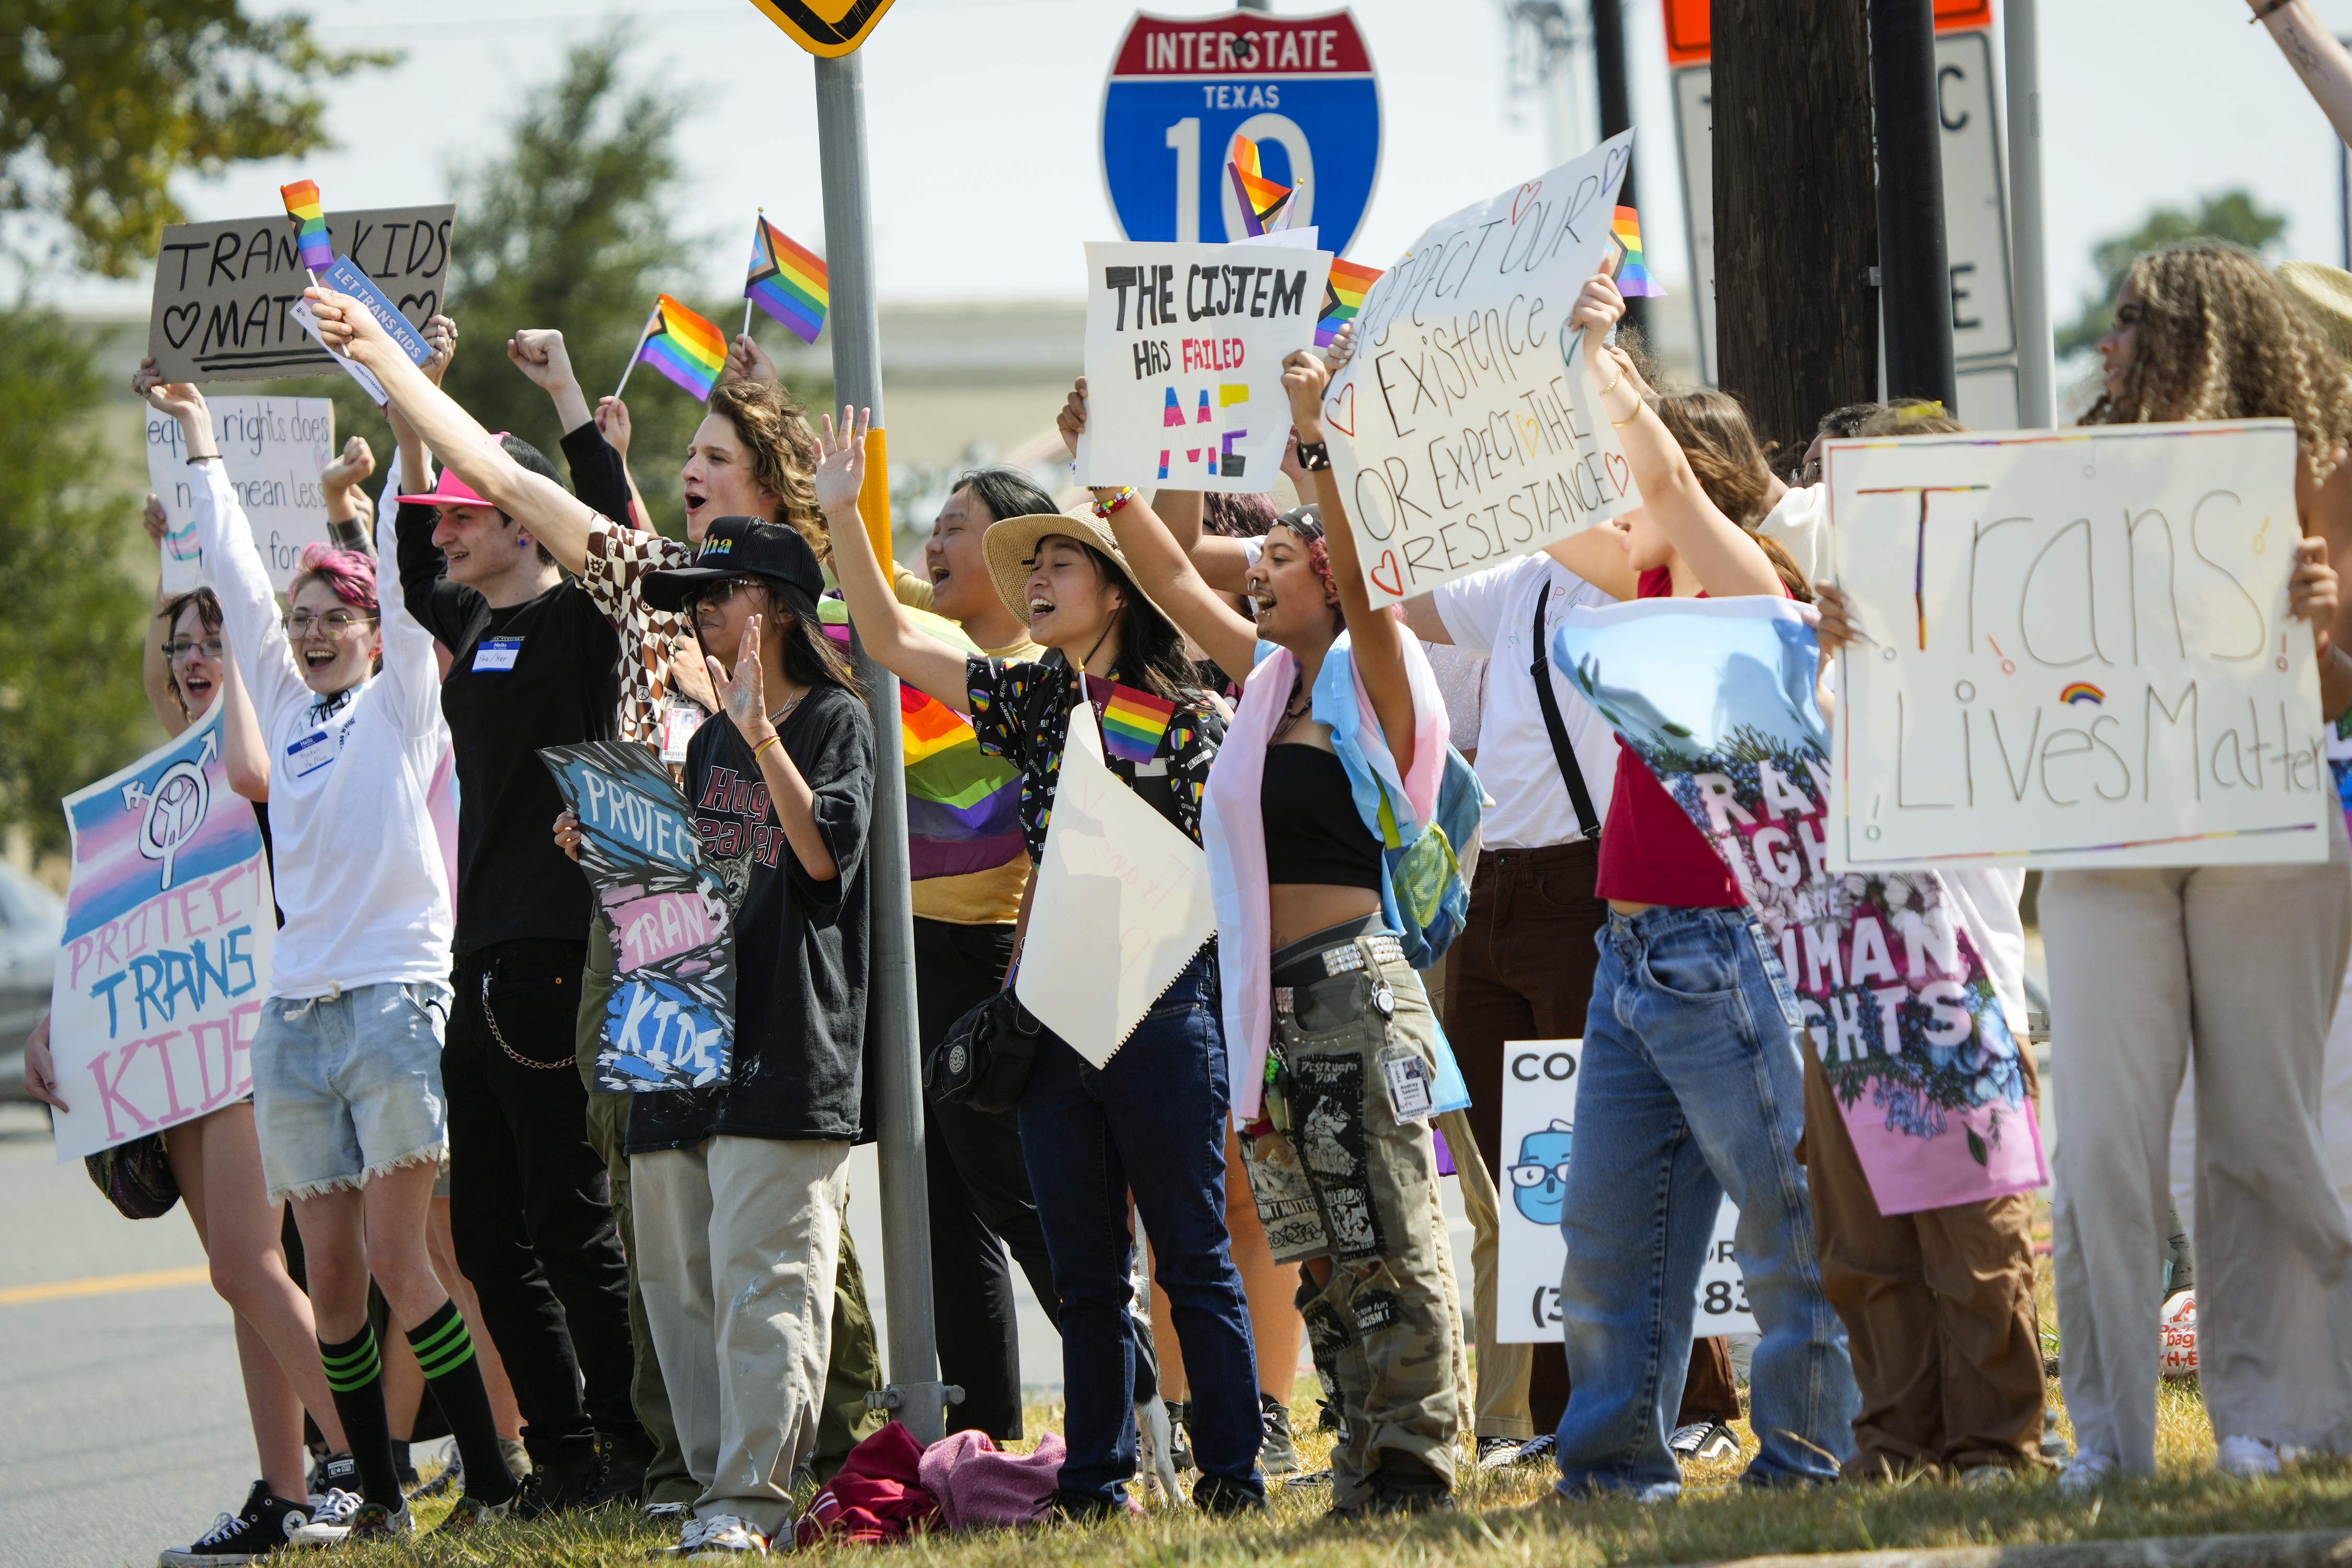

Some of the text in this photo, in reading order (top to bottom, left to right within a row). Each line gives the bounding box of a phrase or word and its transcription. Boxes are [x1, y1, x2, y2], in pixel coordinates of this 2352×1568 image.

[1146, 30, 1339, 71] INTERSTATE
[1203, 85, 1281, 109] TEXAS
[1166, 112, 1315, 243] 10
[163, 218, 452, 291] TRAN KIDS
[1501, 175, 1599, 274] OUR
[333, 267, 422, 359] LET TRANS KIDS
[1105, 264, 1178, 331] THE
[354, 365, 387, 398] EQUALITYTEXAS.ORG
[1133, 337, 1245, 380] HAS FAILED
[223, 400, 286, 456] rights
[291, 399, 329, 443] does
[1157, 383, 1250, 480] ME
[1355, 456, 1433, 541] OR
[1519, 376, 1590, 456] THE
[1402, 452, 1615, 585] RESISTANCE
[1857, 484, 2266, 668] Trans
[300, 737, 313, 747] Hello
[1898, 678, 2131, 810] Lives
[2144, 680, 2327, 804] Matter
[580, 769, 705, 872] PROTECT
[694, 811, 785, 869] ealer
[66, 852, 263, 991] PROTECT
[626, 876, 729, 966] TRANS
[1797, 889, 1842, 919] ARE
[89, 925, 258, 1039] TRANS
[87, 999, 262, 1143] KIDS
[618, 981, 723, 1088] KIDS
[2166, 1333, 2195, 1348] bag
